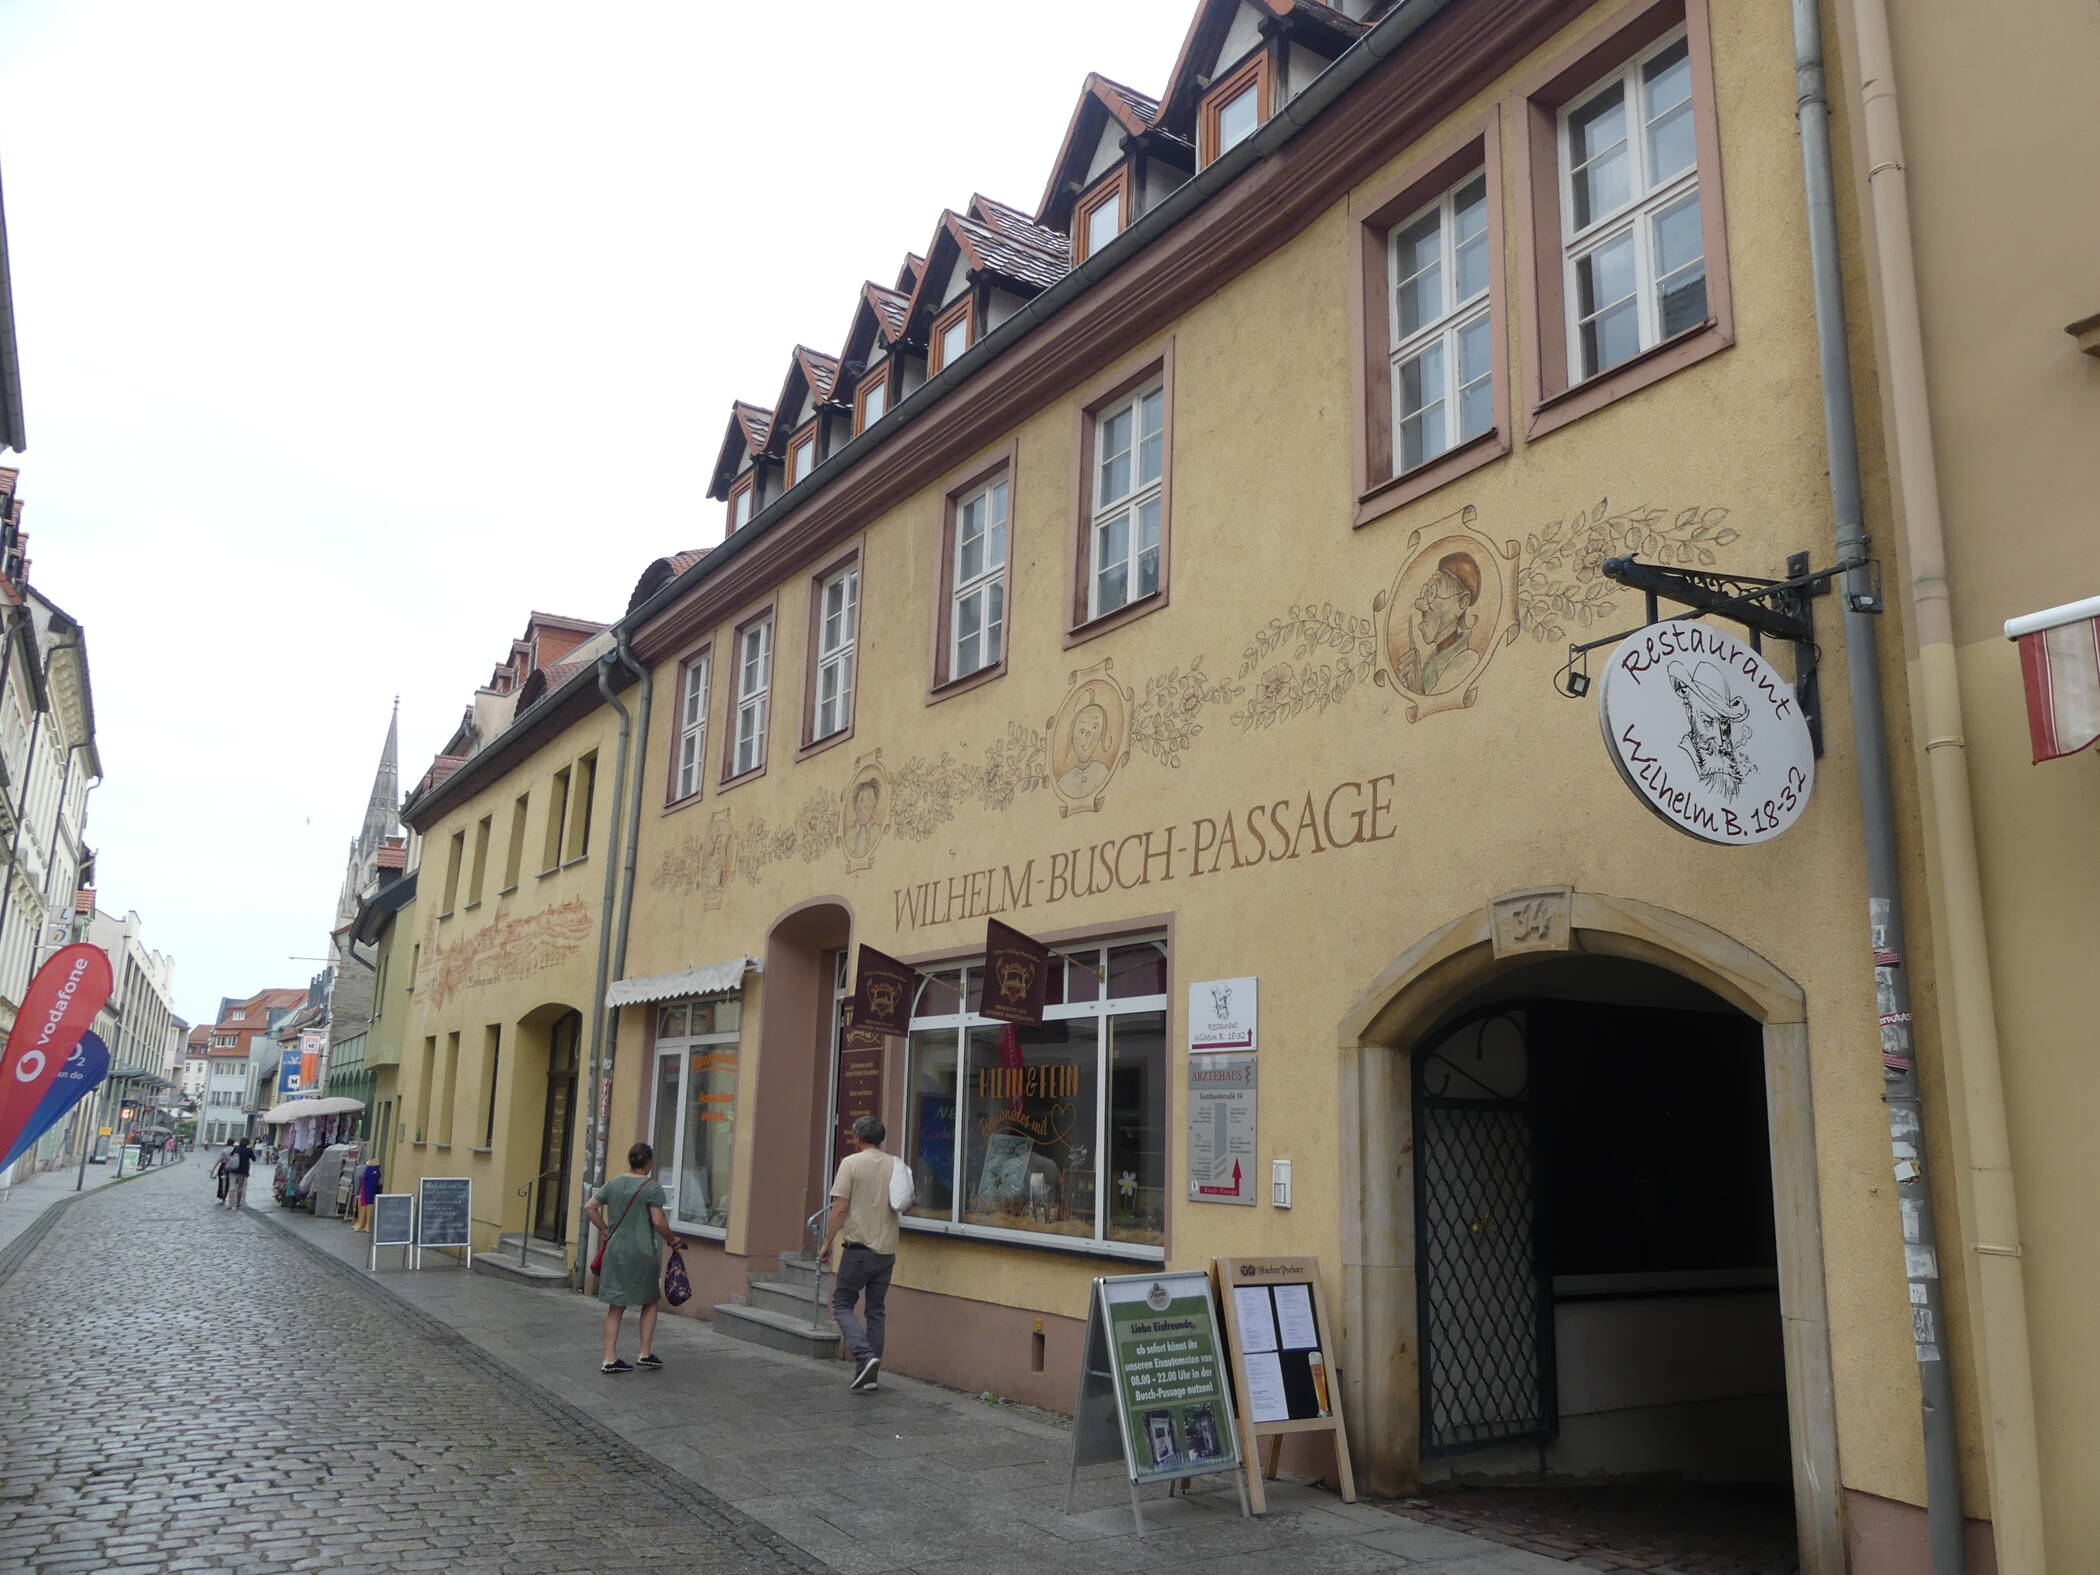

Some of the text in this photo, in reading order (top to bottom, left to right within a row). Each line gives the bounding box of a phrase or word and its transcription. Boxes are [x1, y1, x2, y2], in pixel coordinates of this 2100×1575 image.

[1621, 623, 1791, 721] Restaurant
[1622, 723, 1807, 837] Wilhelm B. 18-32
[893, 773, 1398, 934] WILHELM-BUSCH-PASSAGE
[37, 957, 89, 1046] vodafone
[1040, 1064, 1080, 1098] FEIN
[1031, 1116, 1049, 1137] mit
[1131, 1318, 1196, 1334] Liebe Eisfreunde,
[1136, 1344, 1146, 1355] ab
[1146, 1342, 1166, 1354] sofort
[1167, 1341, 1187, 1351] könnt
[1125, 1354, 1213, 1371] unseren Eisautomaten von
[1130, 1374, 1151, 1386] 08.00
[1158, 1371, 1177, 1383] 22.00
[1178, 1369, 1191, 1380] Uhr
[1192, 1368, 1201, 1378] in
[1201, 1367, 1213, 1377] der
[1135, 1381, 1214, 1401] Busch-Passage nutzen!
